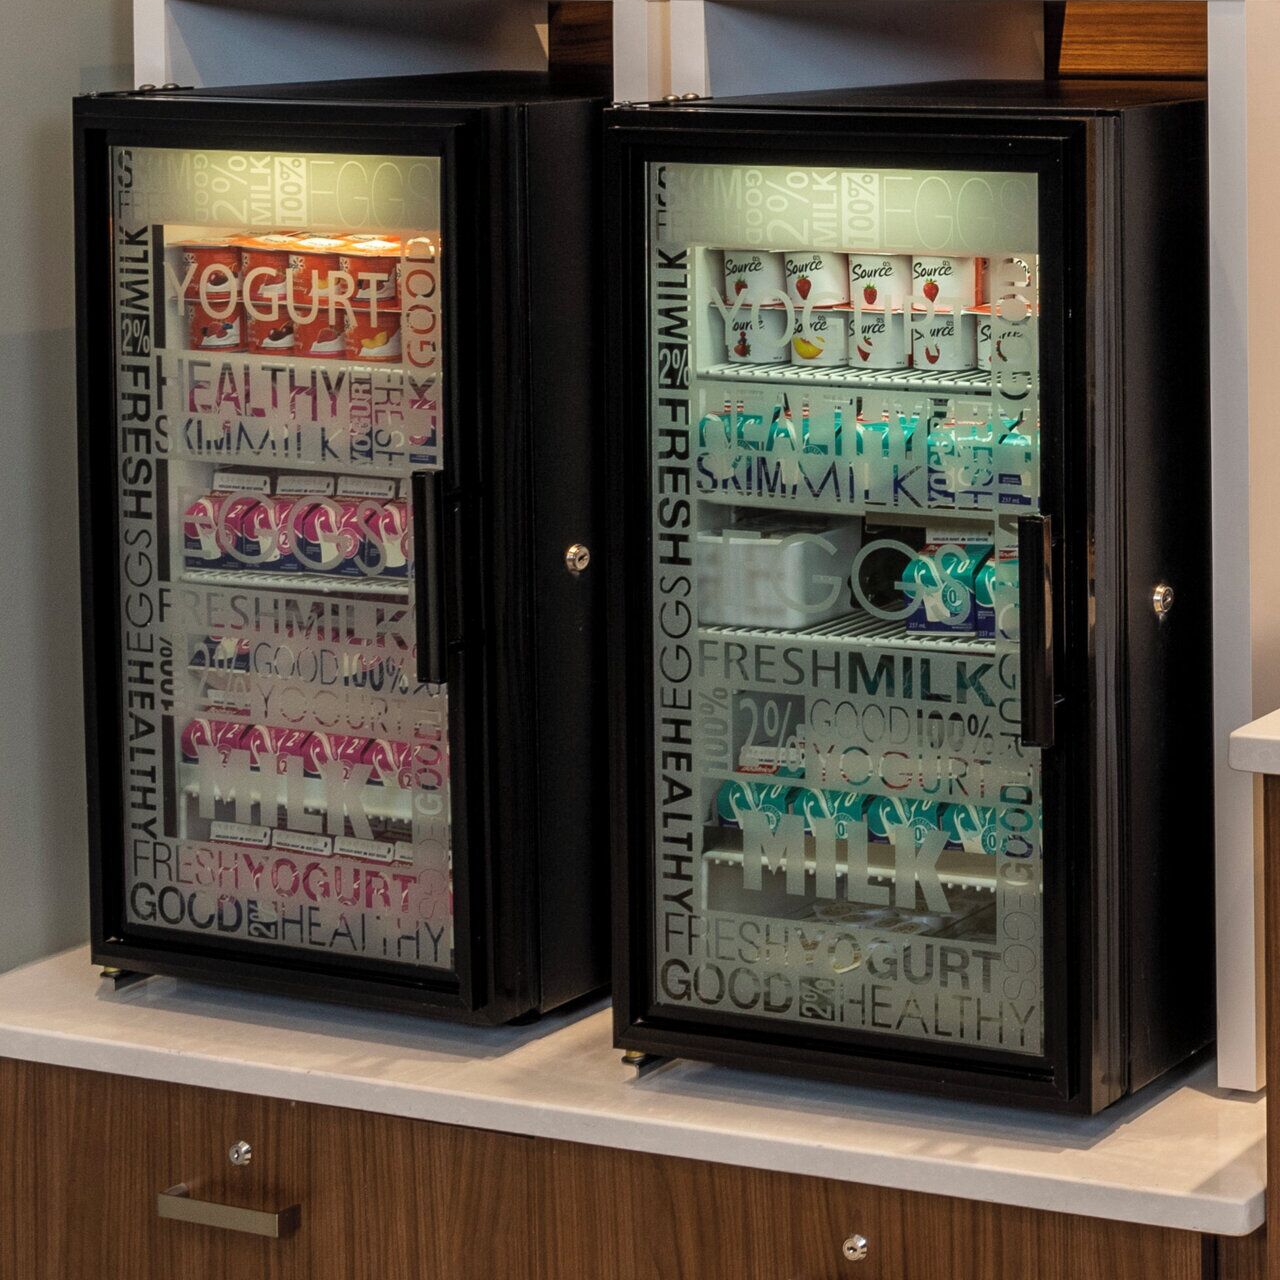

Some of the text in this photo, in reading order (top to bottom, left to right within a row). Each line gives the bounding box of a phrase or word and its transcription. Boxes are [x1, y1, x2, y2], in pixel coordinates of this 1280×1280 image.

[211, 155, 248, 224] 2%
[249, 155, 272, 225] MILK
[279, 157, 305, 224] 100%
[745, 169, 763, 245] GOOD
[765, 170, 810, 245] 2%
[812, 171, 838, 247] MILK
[848, 173, 876, 245] 100%
[119, 224, 149, 312] MILK
[164, 261, 389, 330] YOGURT
[405, 235, 437, 368] GOOD
[657, 248, 689, 341] MILK
[725, 258, 764, 276] Source
[786, 259, 824, 277] Source
[852, 263, 896, 281] Source
[913, 262, 954, 279] Source
[122, 319, 150, 354] 2%
[793, 319, 829, 335] Sorce
[849, 320, 886, 337] Surce
[914, 325, 954, 341] Surce
[157, 355, 345, 422] HEALTHY
[659, 348, 689, 387] 2%
[121, 364, 152, 520] FRESH
[406, 372, 437, 466] ILK
[658, 396, 692, 565] FRESH
[178, 487, 387, 577] EGGS
[125, 528, 154, 653] EGGS
[722, 528, 971, 626] EGGS
[284, 598, 409, 650] MILK
[659, 573, 692, 712] EGGS
[253, 641, 339, 686] GOOD
[698, 639, 997, 707] FRESH MILK
[127, 659, 157, 840] HEALTHY
[702, 686, 729, 771] 100%
[809, 698, 994, 756] GOOD 100%
[199, 746, 375, 840] MILK
[813, 742, 992, 798] YOGURT
[661, 716, 693, 913] HEALTHY
[1000, 785, 1034, 886] GOOD
[133, 838, 417, 912] FRESH YOGURT
[743, 806, 951, 913] MILK
[130, 881, 242, 933] GOOD
[665, 911, 1000, 993] FRESH YOGURT
[661, 958, 793, 1014] GOOD
[840, 983, 1035, 1047] HEALTHY
